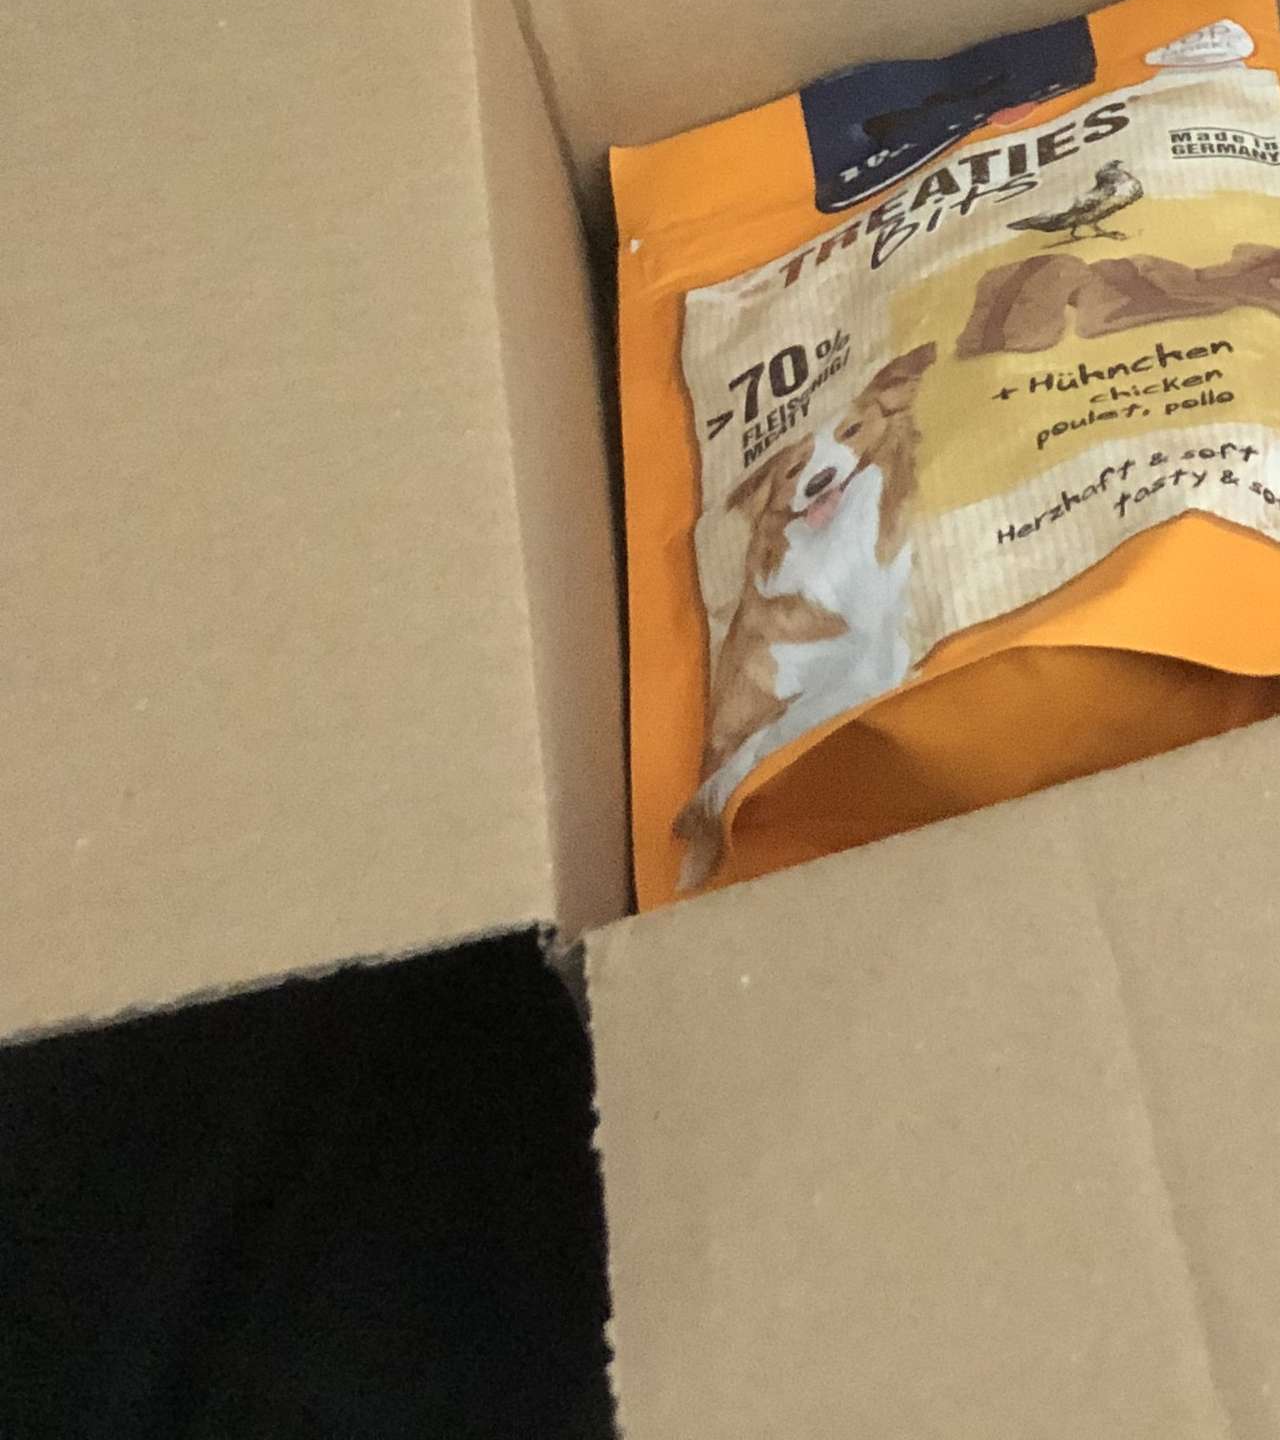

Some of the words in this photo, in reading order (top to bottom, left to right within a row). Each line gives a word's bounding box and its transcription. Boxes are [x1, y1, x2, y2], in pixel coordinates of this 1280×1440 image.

[1170, 131, 1245, 144] Made
[1170, 142, 1280, 163] GERMANY
[1028, 336, 1235, 394] Hühnchen
[1090, 368, 1224, 404] chicken
[1164, 386, 1236, 416] pollo
[996, 458, 1138, 546] Herzhaft
[1149, 450, 1170, 468] &
[1182, 442, 1260, 463] soft
[1114, 467, 1207, 518] tasty
[1219, 469, 1241, 488] &
